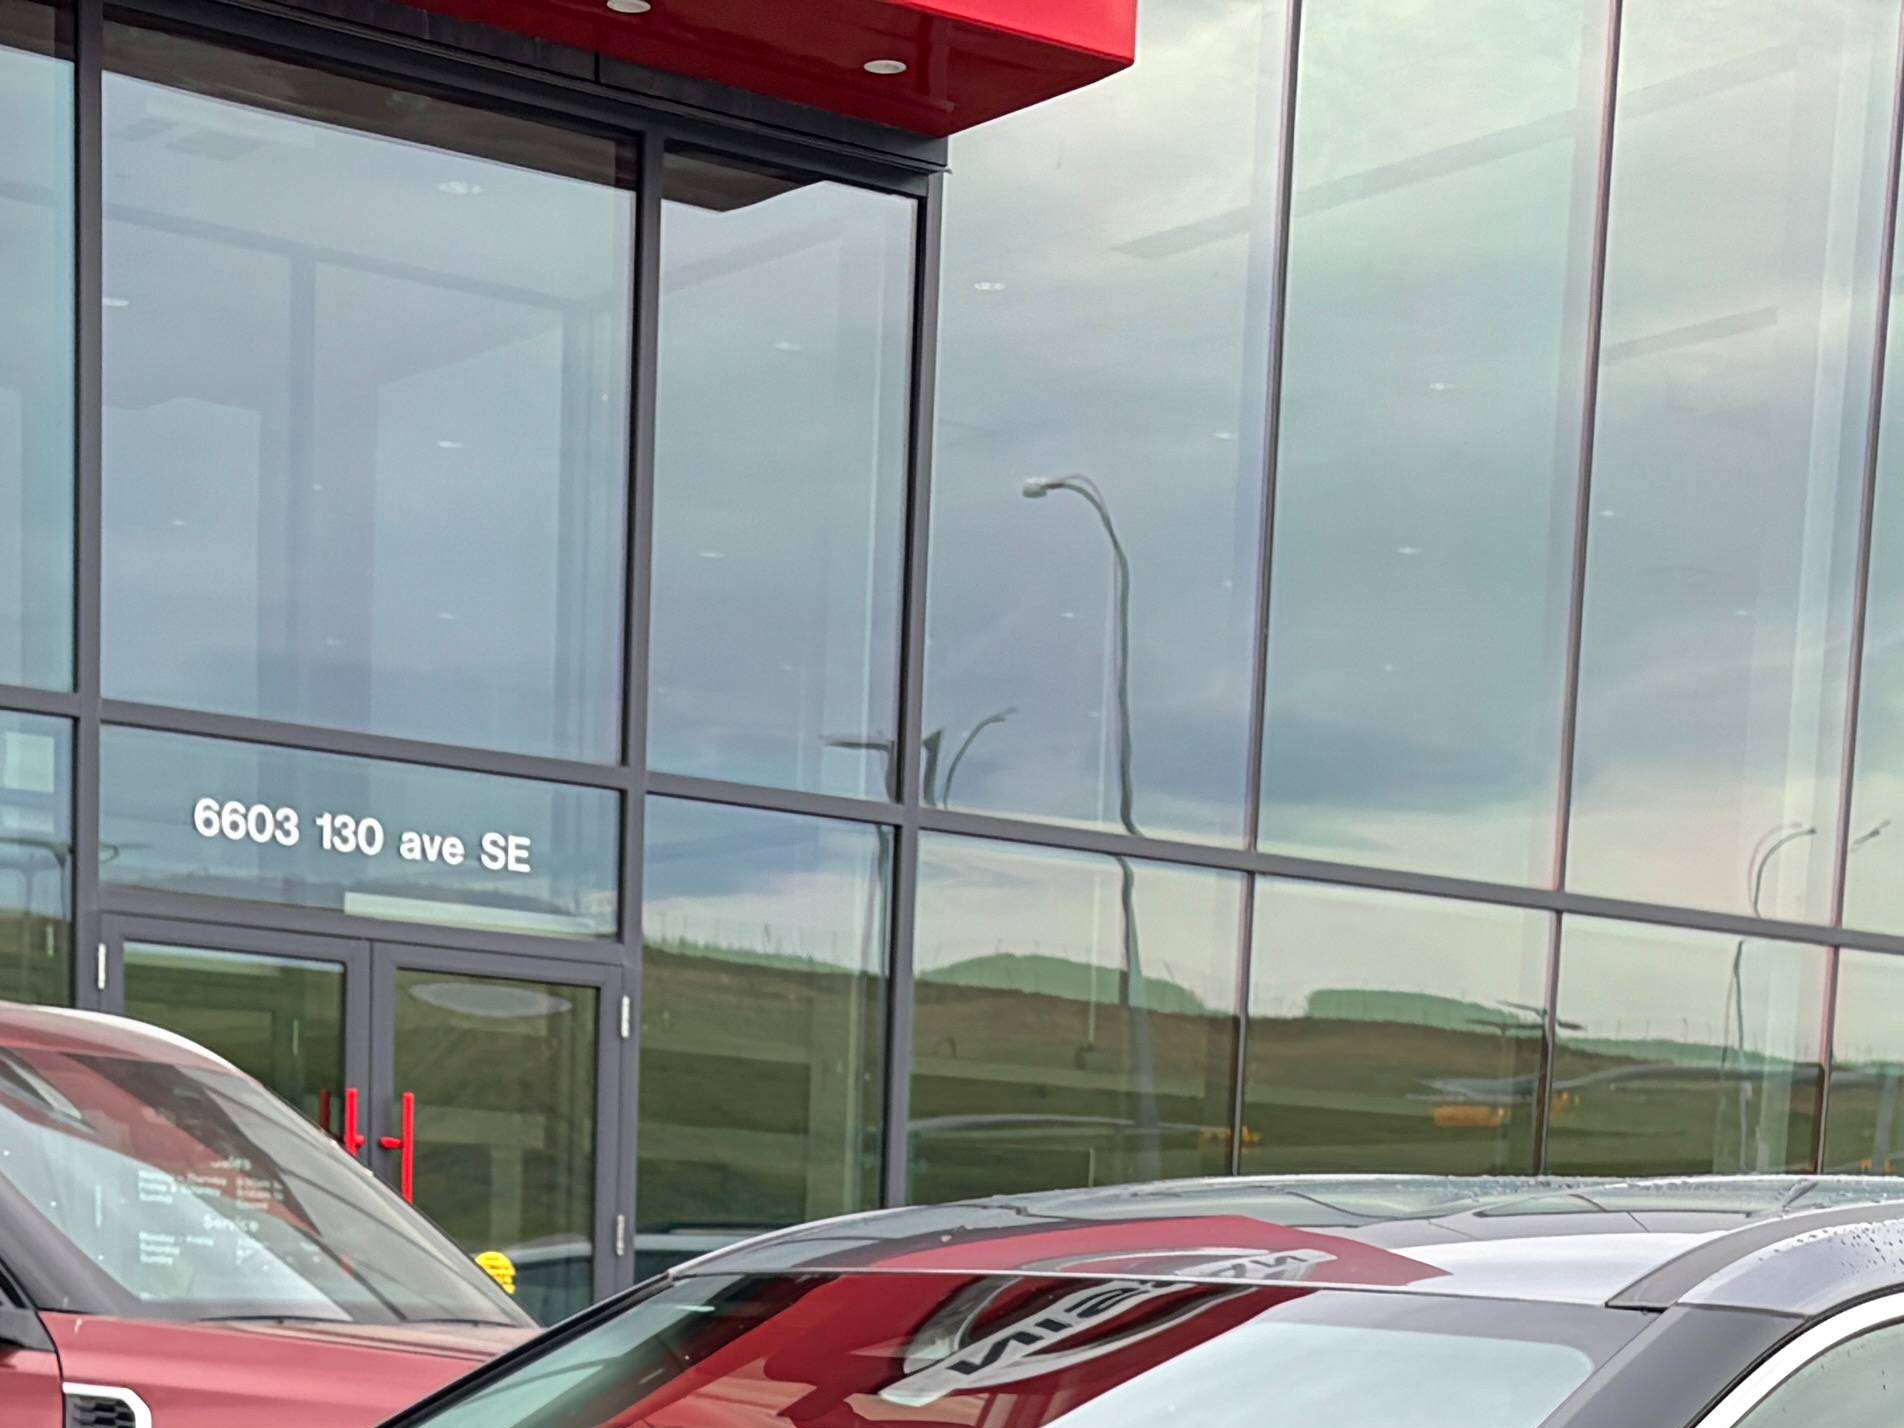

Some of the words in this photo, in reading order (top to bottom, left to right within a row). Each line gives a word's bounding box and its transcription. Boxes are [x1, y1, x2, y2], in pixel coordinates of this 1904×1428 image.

[193, 797, 300, 846] 6603
[315, 811, 384, 857] 130
[399, 833, 465, 866] ave
[480, 831, 532, 873] SE
